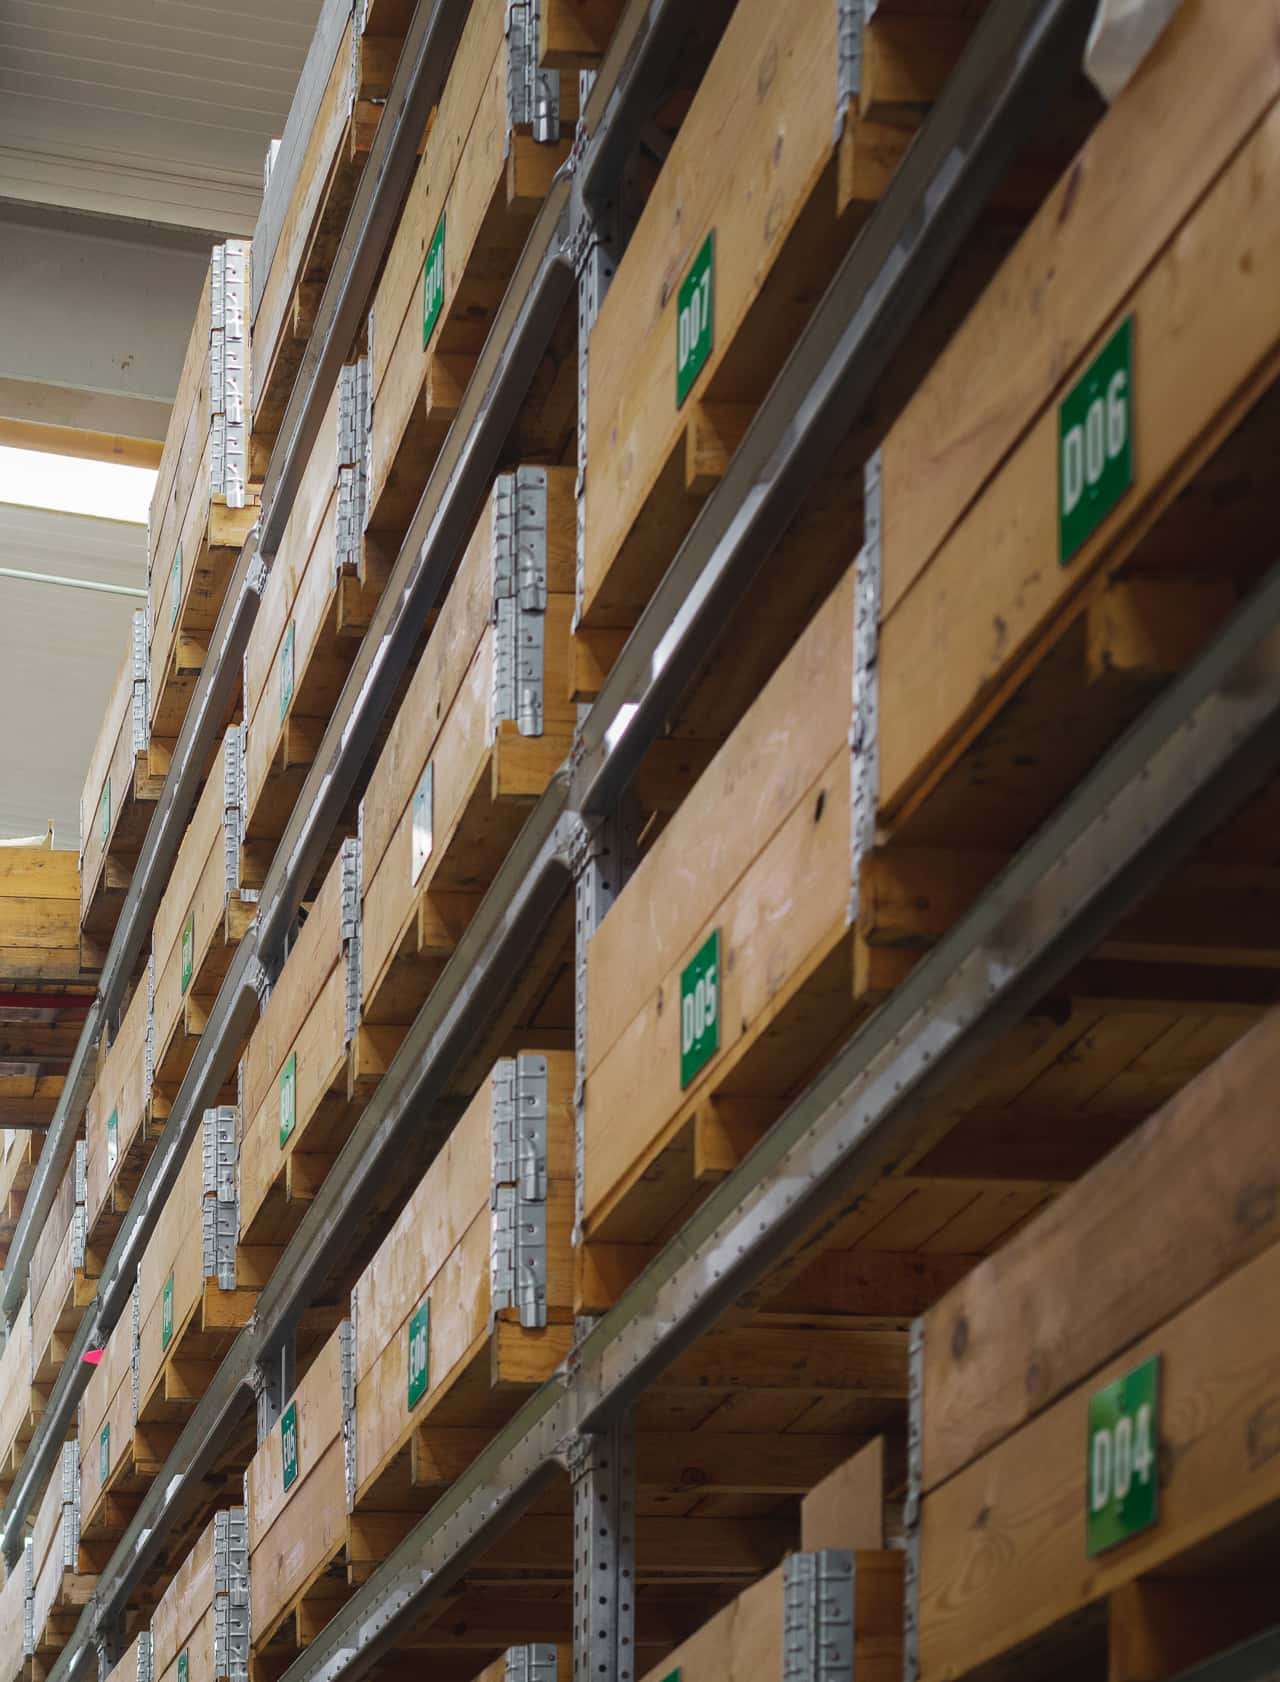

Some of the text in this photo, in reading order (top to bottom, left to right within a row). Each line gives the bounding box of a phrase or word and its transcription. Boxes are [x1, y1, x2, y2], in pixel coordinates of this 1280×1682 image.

[679, 266, 711, 372] D07
[1063, 370, 1126, 516] D06
[683, 965, 716, 1055] D05
[1092, 1403, 1154, 1512] D04
